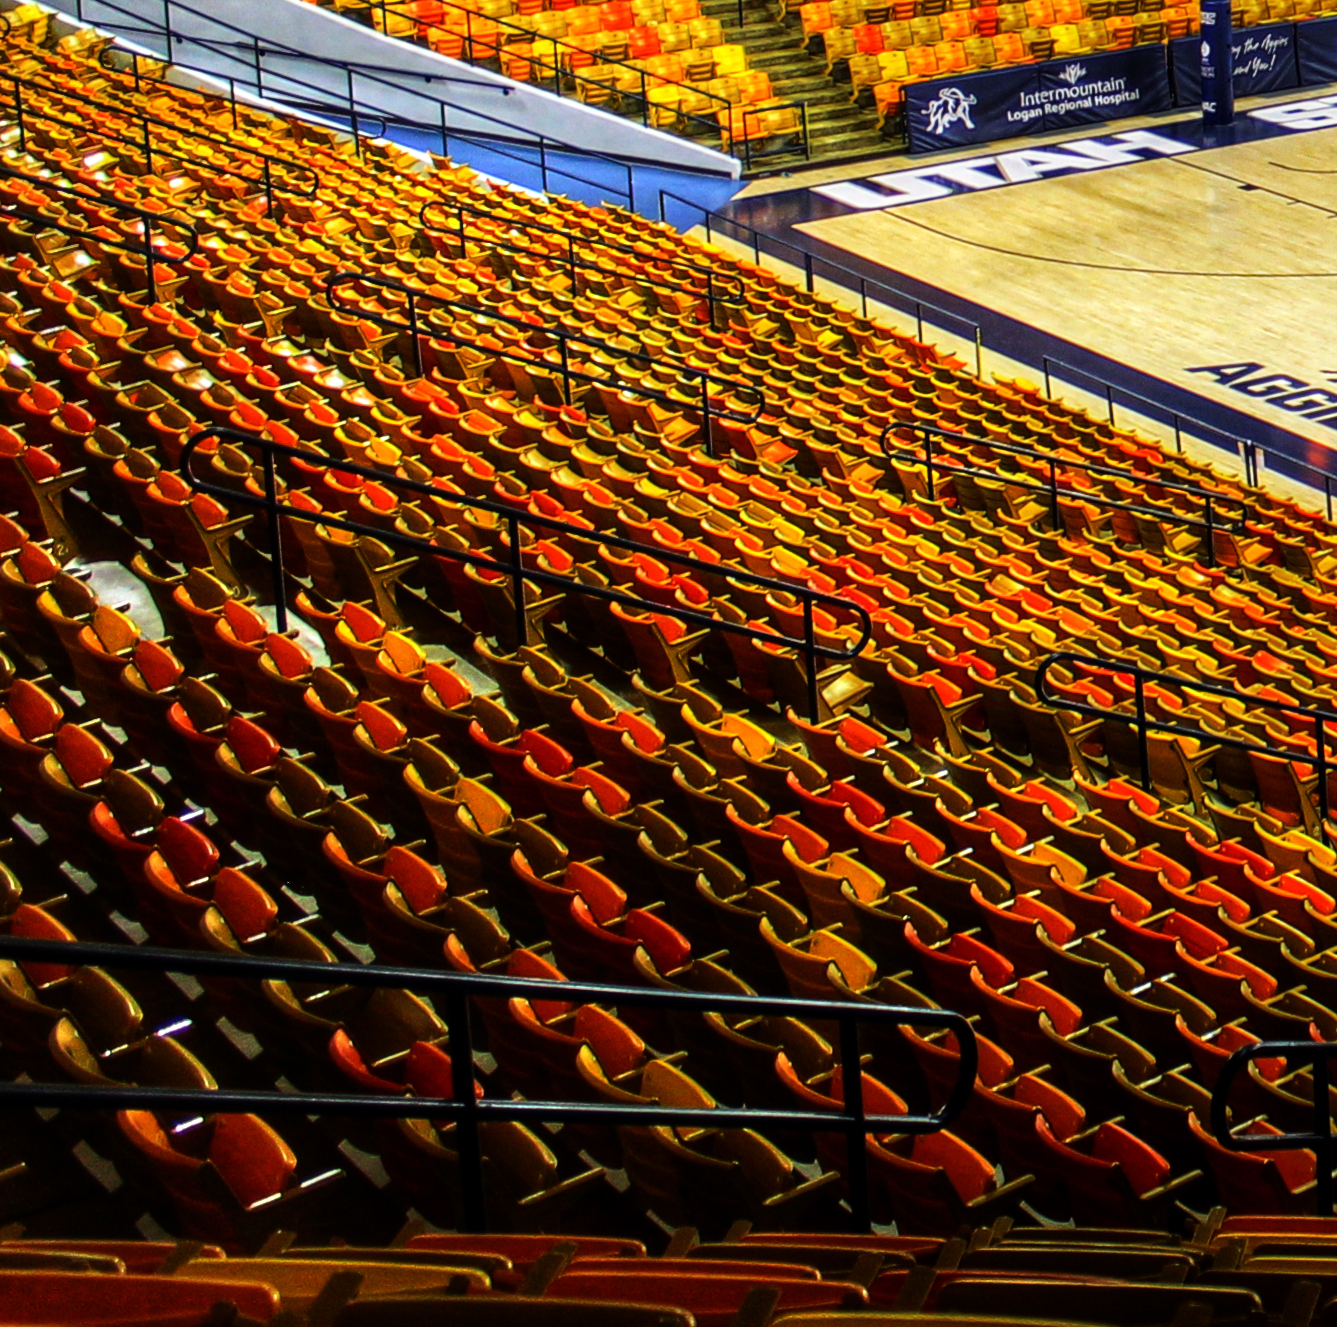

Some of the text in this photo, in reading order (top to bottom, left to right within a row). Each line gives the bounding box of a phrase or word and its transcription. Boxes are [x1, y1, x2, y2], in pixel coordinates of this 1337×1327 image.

[1007, 87, 1140, 123] Logan Regional Hospital
[1019, 76, 1126, 107] Intermountain
[810, 128, 1200, 211] UTAH
